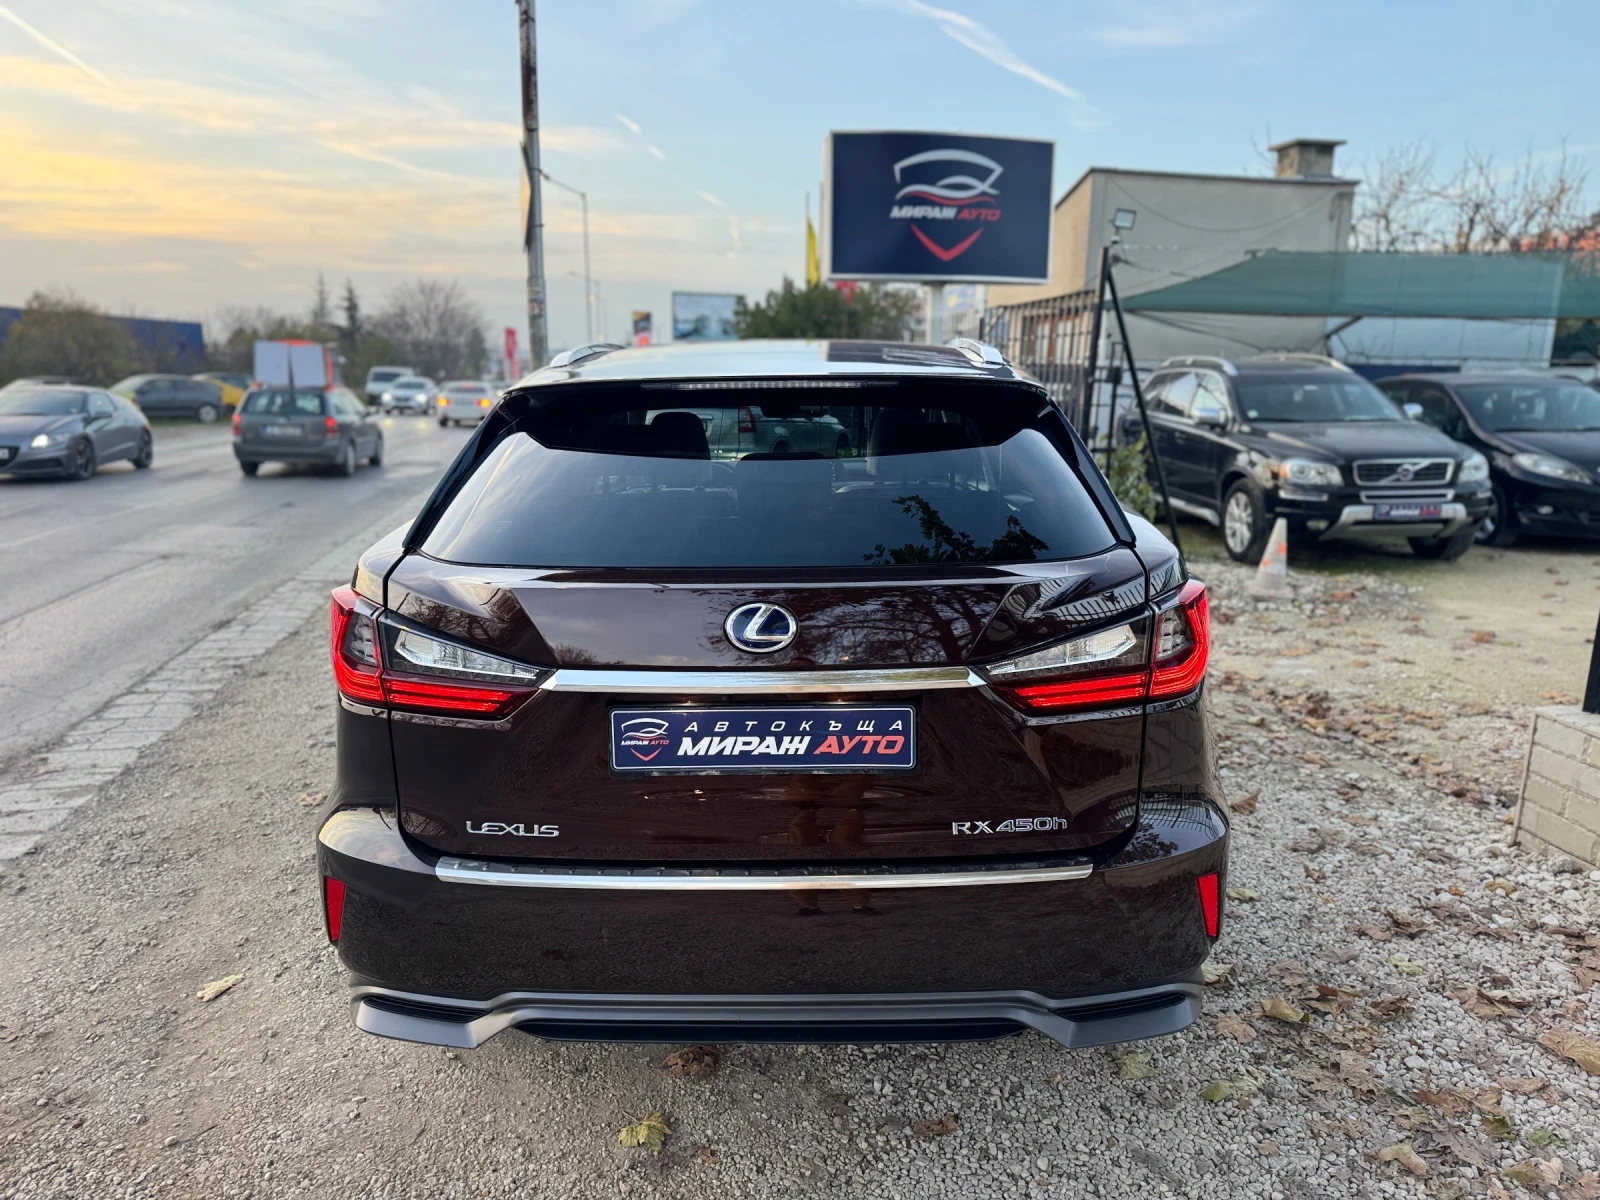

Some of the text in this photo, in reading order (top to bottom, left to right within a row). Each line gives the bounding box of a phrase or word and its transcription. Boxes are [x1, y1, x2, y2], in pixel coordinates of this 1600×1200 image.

[889, 204, 1002, 222] МИРАЖ АУТО
[684, 720, 903, 732] АВТОКЪЩА
[677, 735, 905, 756] МИРАЖ АУТО
[465, 820, 560, 838] LEXUS
